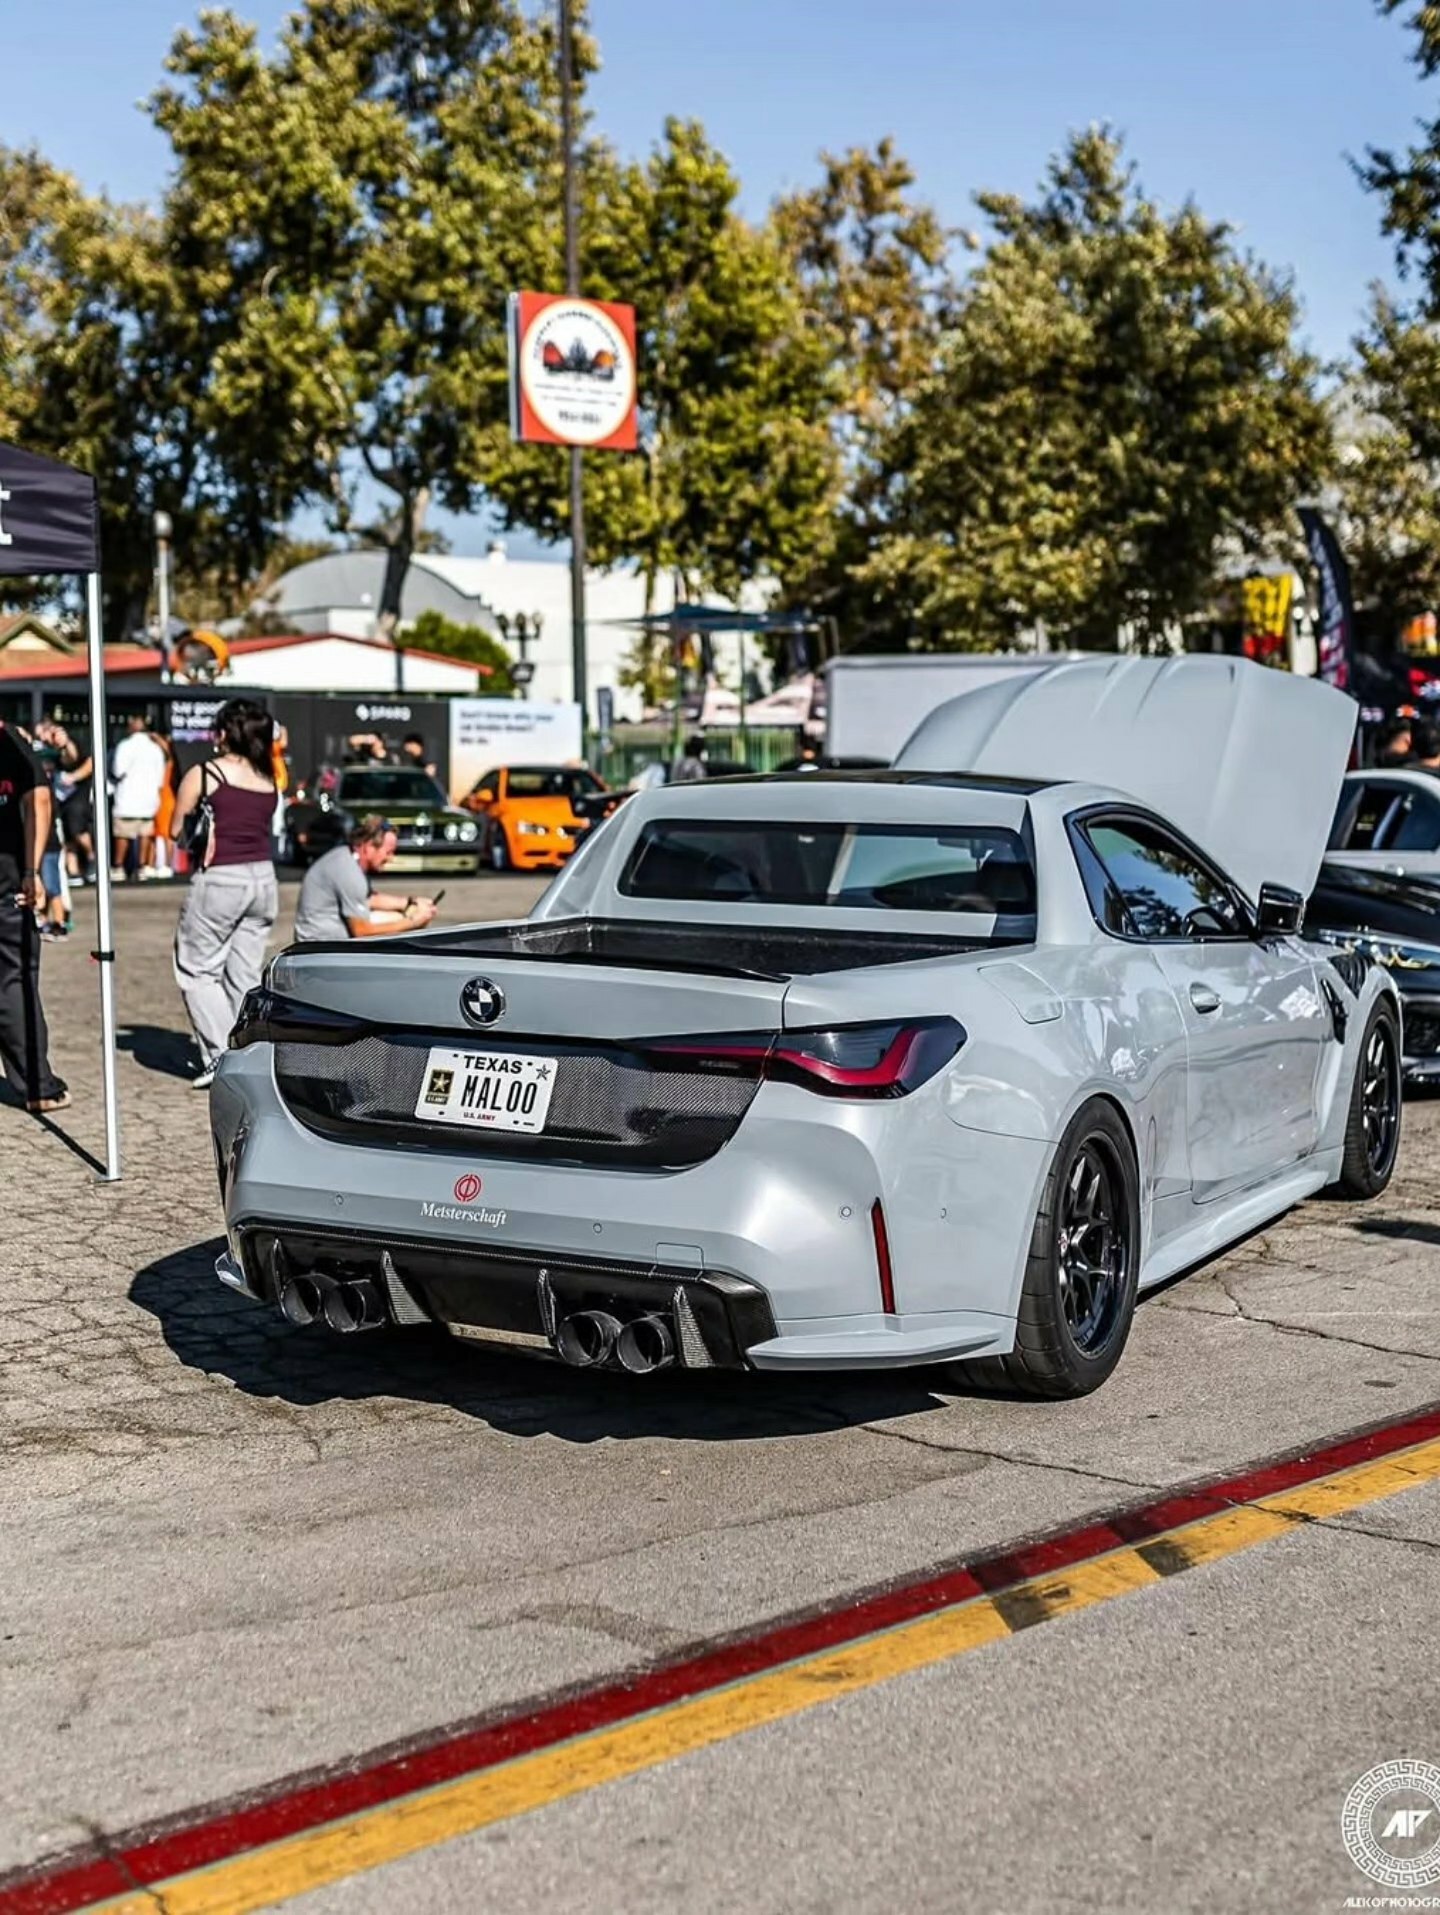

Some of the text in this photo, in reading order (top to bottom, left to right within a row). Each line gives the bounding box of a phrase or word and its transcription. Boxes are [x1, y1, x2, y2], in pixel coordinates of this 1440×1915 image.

[463, 1055, 523, 1074] TEXAS
[463, 1111, 496, 1121] U.S. ARMY
[420, 1202, 508, 1228] Meisterschaft
